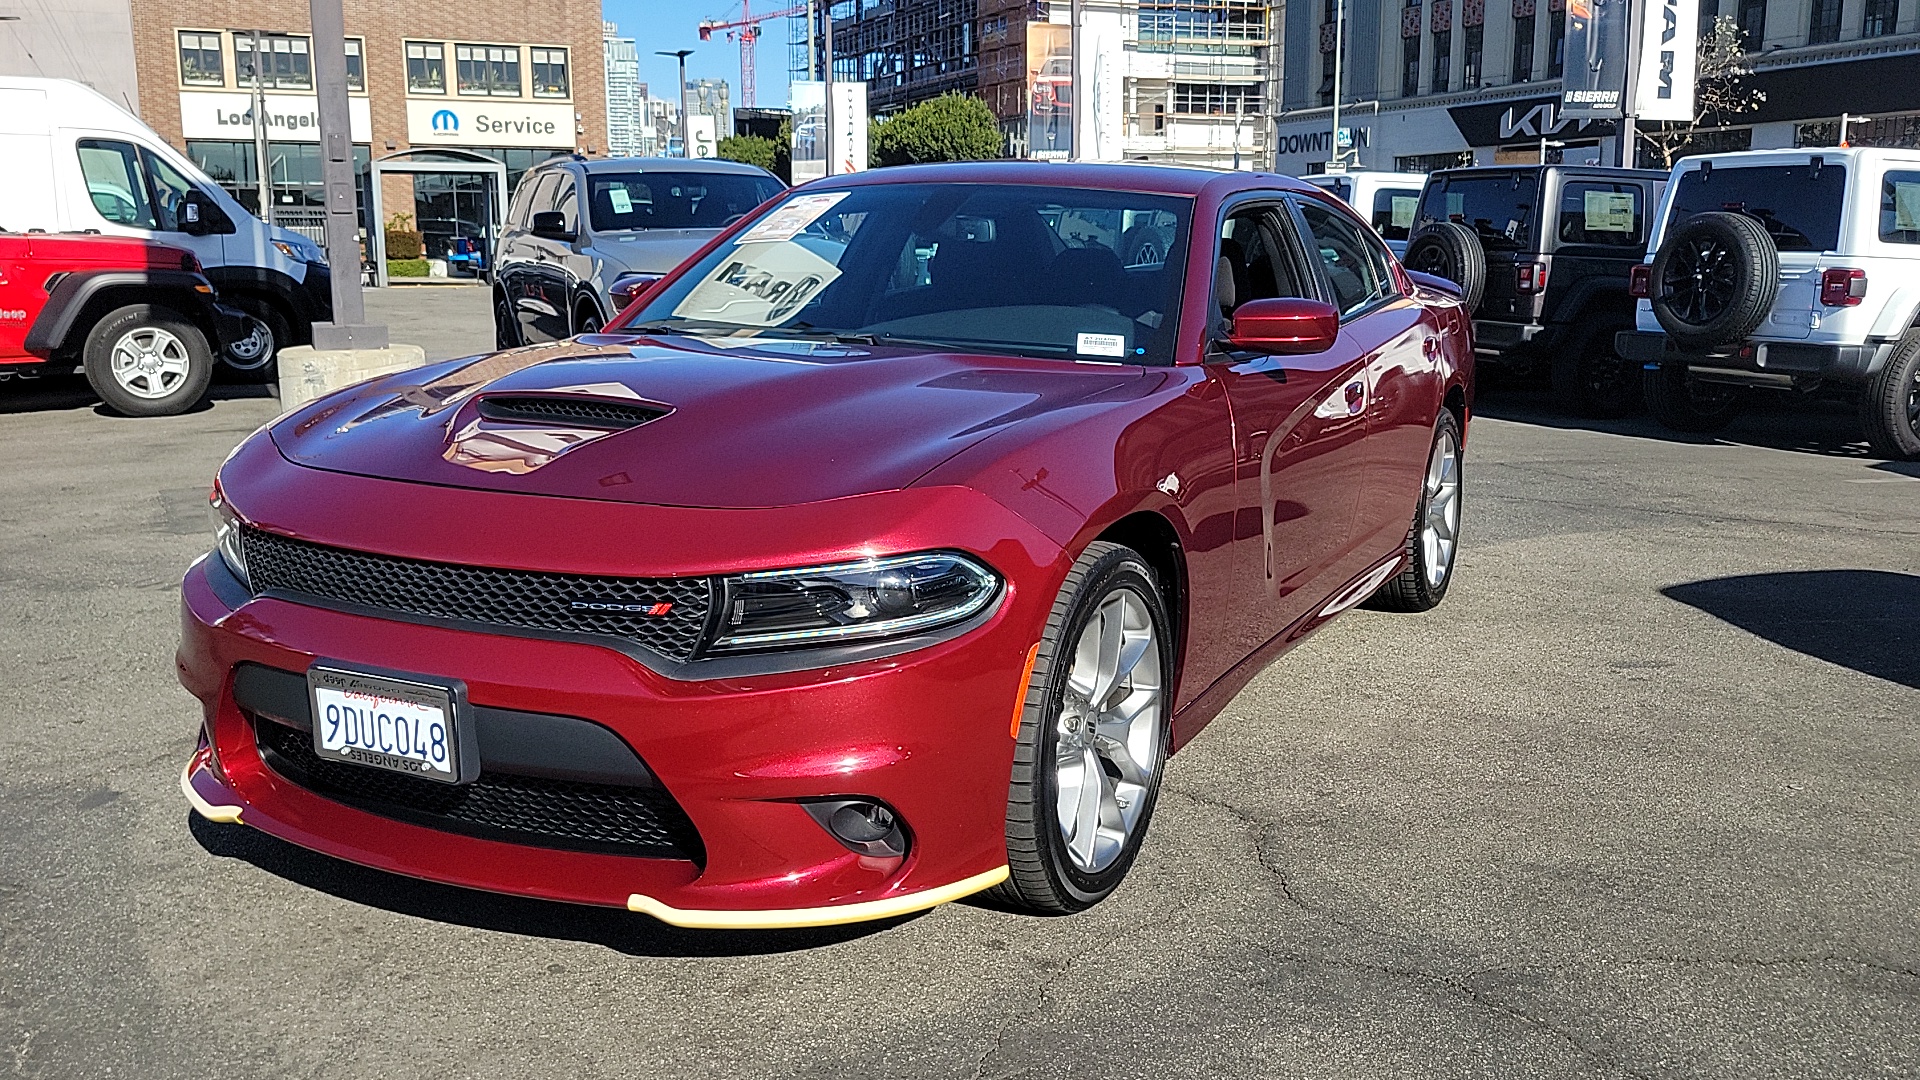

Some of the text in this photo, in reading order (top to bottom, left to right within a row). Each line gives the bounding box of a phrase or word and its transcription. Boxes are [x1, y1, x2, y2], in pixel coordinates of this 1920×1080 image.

[1657, 0, 1677, 99] AM
[1572, 90, 1620, 103] SIERRA
[217, 109, 321, 130] Los Angel
[476, 114, 556, 135] Service
[1279, 126, 1370, 154] DOWNTWN
[571, 601, 656, 613] DODGE
[326, 703, 446, 763] 9DUC048
[350, 749, 399, 766] ANGELES
